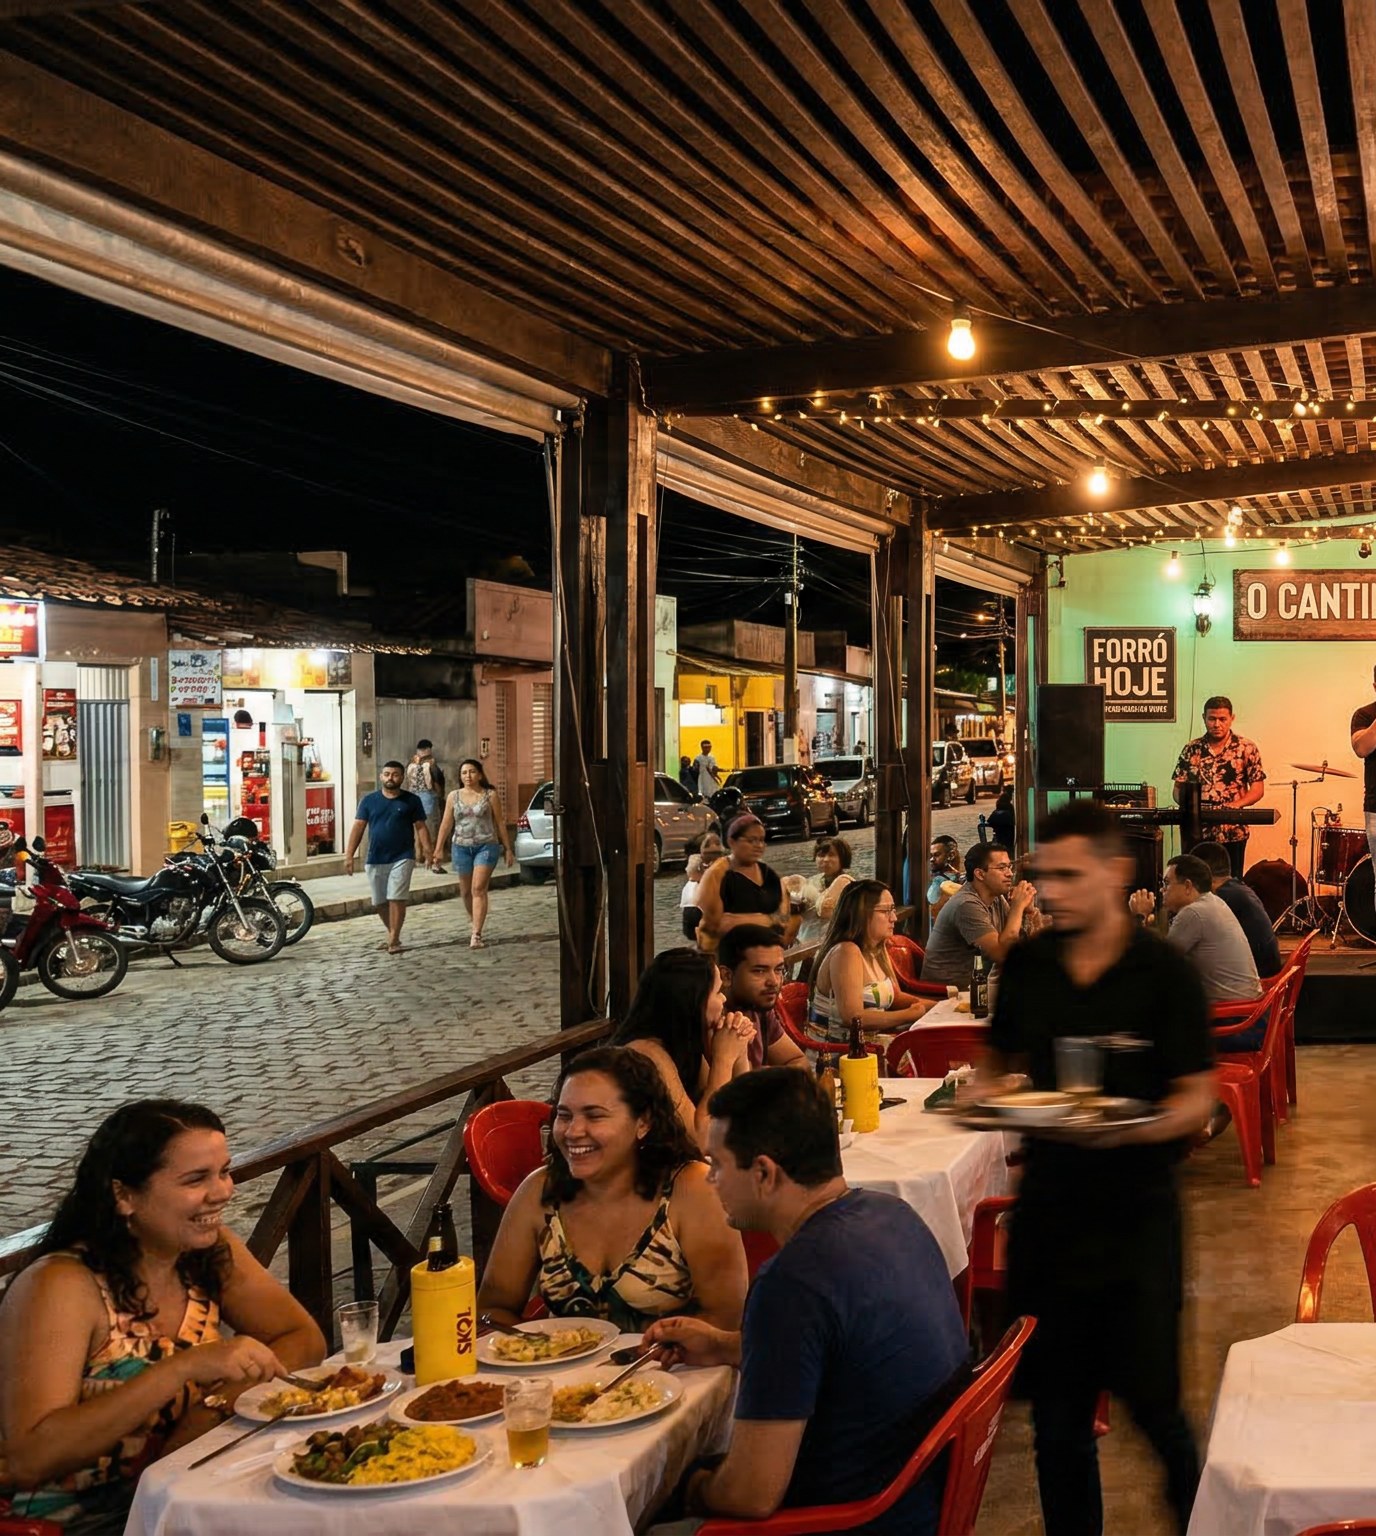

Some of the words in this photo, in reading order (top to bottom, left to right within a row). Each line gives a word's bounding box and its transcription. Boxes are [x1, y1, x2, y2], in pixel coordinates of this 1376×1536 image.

[1246, 582, 1268, 620] O
[1093, 632, 1168, 664] FORRÓ
[1094, 666, 1168, 697] HOJE
[456, 1306, 473, 1356] SKOL
